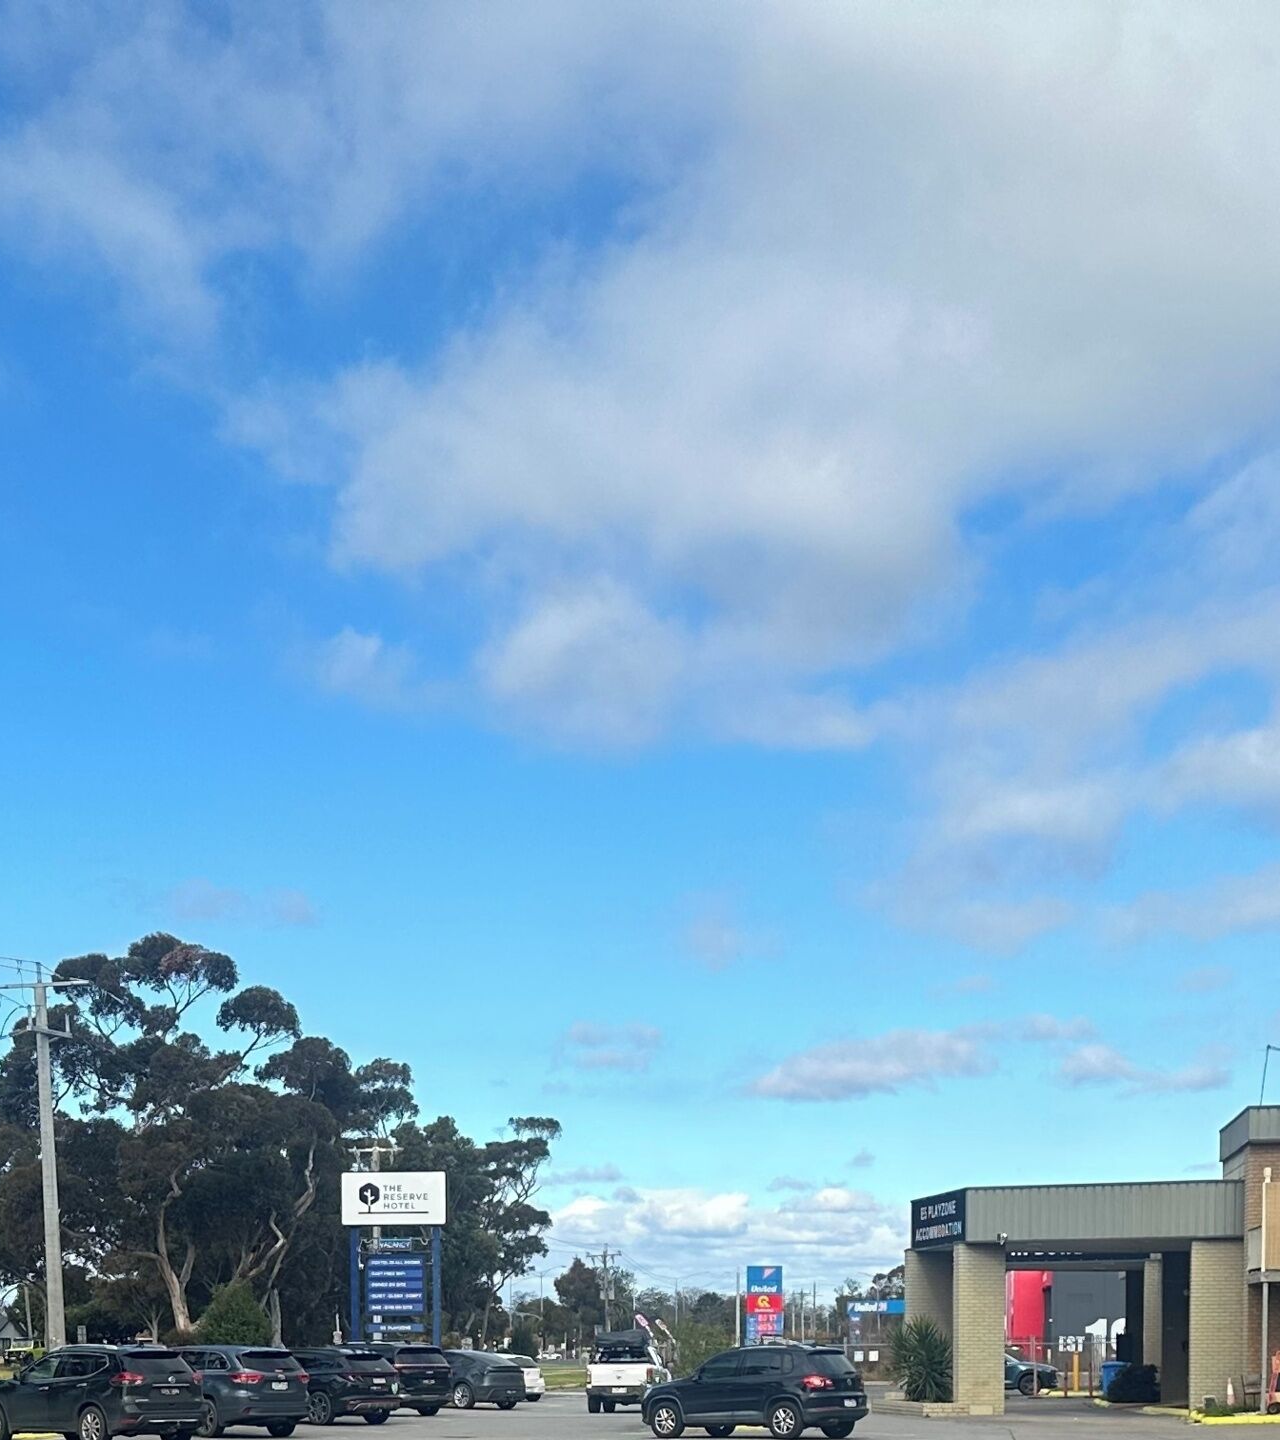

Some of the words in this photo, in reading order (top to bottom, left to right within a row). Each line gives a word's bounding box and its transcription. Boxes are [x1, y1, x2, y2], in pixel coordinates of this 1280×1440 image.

[383, 1184, 403, 1192] THE
[383, 1193, 429, 1201] RESERVE
[915, 1221, 962, 1241] ACCOMMODATION
[751, 1285, 778, 1293] United
[1058, 1335, 1086, 1352] EST
